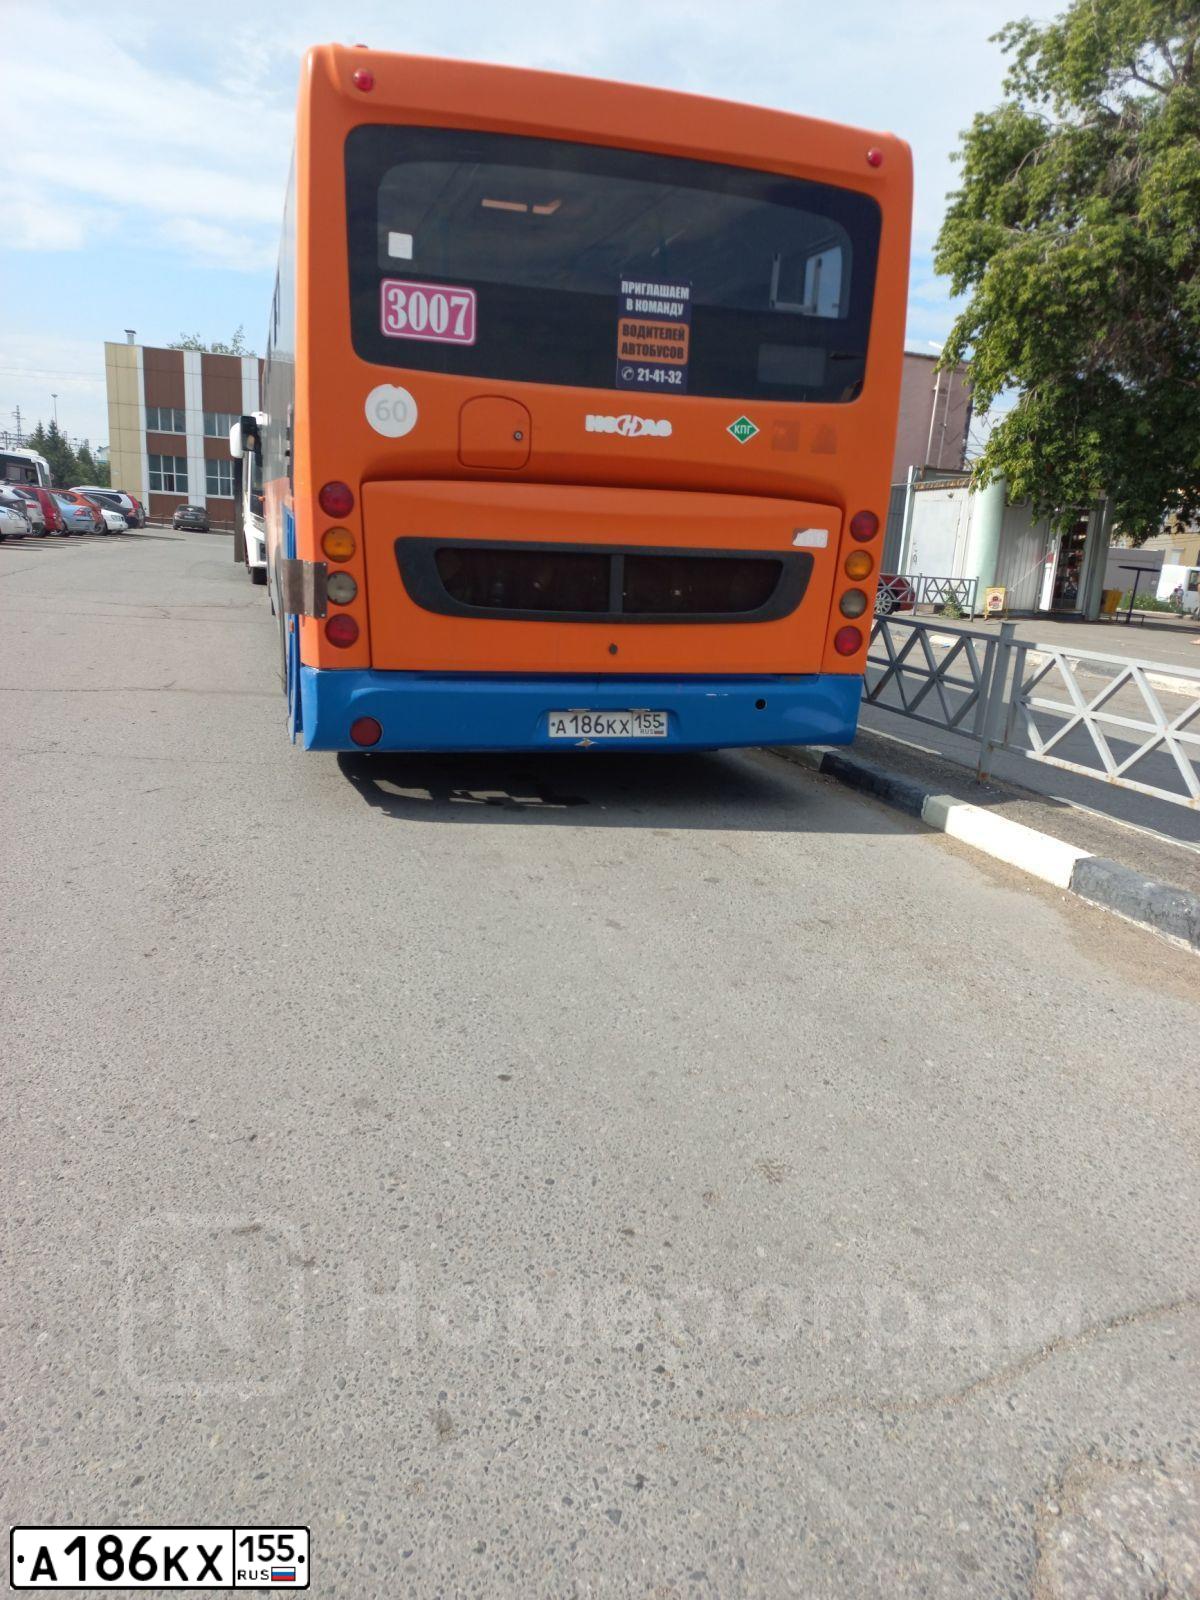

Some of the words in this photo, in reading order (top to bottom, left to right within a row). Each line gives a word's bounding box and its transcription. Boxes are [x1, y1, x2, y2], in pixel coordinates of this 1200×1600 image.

[621, 281, 690, 300] ПРИГЛАШАЕМ
[388, 288, 470, 336] 3007
[626, 298, 634, 311] В
[635, 299, 684, 317] КОМАНДУ
[622, 324, 685, 341] ВОДИТЕЛЕЙ
[621, 342, 684, 359] АВТОБУСОВ
[637, 368, 682, 384] 21-41-32
[375, 400, 407, 423] 60
[734, 425, 752, 435] КПГ
[634, 714, 661, 729] 155
